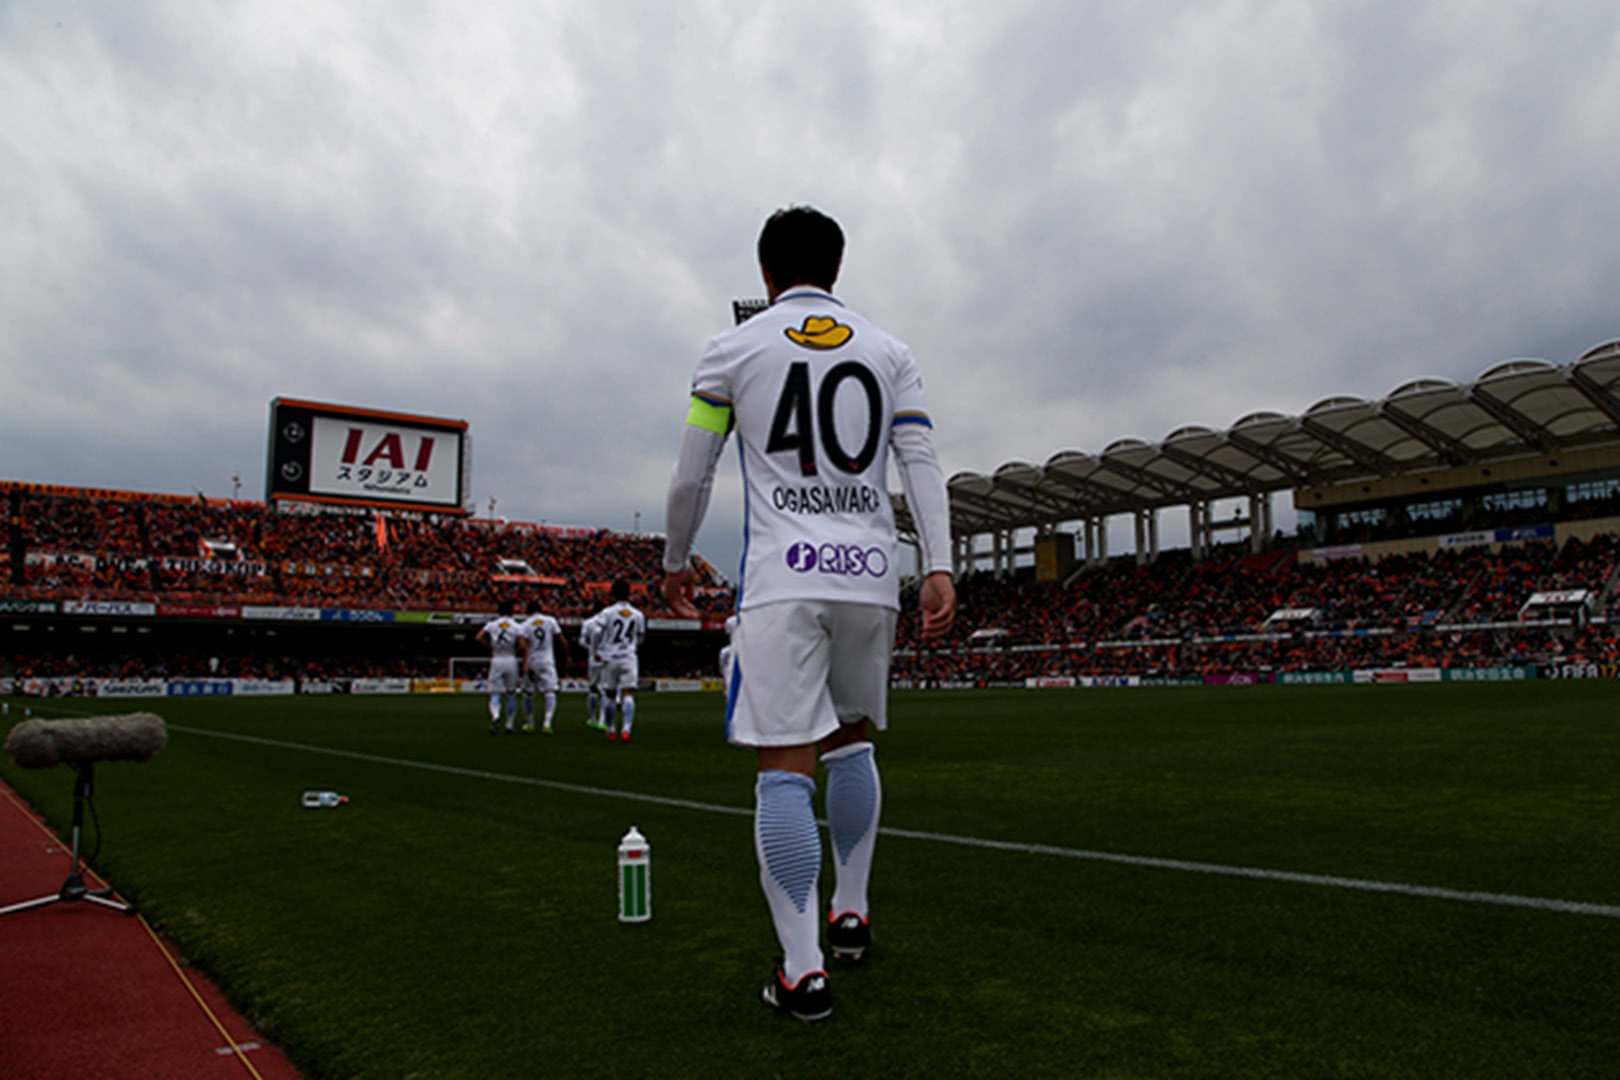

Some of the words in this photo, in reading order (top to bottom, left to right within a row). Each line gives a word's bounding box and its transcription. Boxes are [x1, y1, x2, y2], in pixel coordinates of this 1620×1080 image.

[765, 361, 882, 476] 40
[341, 428, 434, 471] IAI
[336, 466, 428, 487] スタジアム
[818, 543, 888, 577] RISO
[534, 626, 545, 647] 9
[613, 619, 635, 643] 24
[1561, 664, 1599, 680] FIFA
